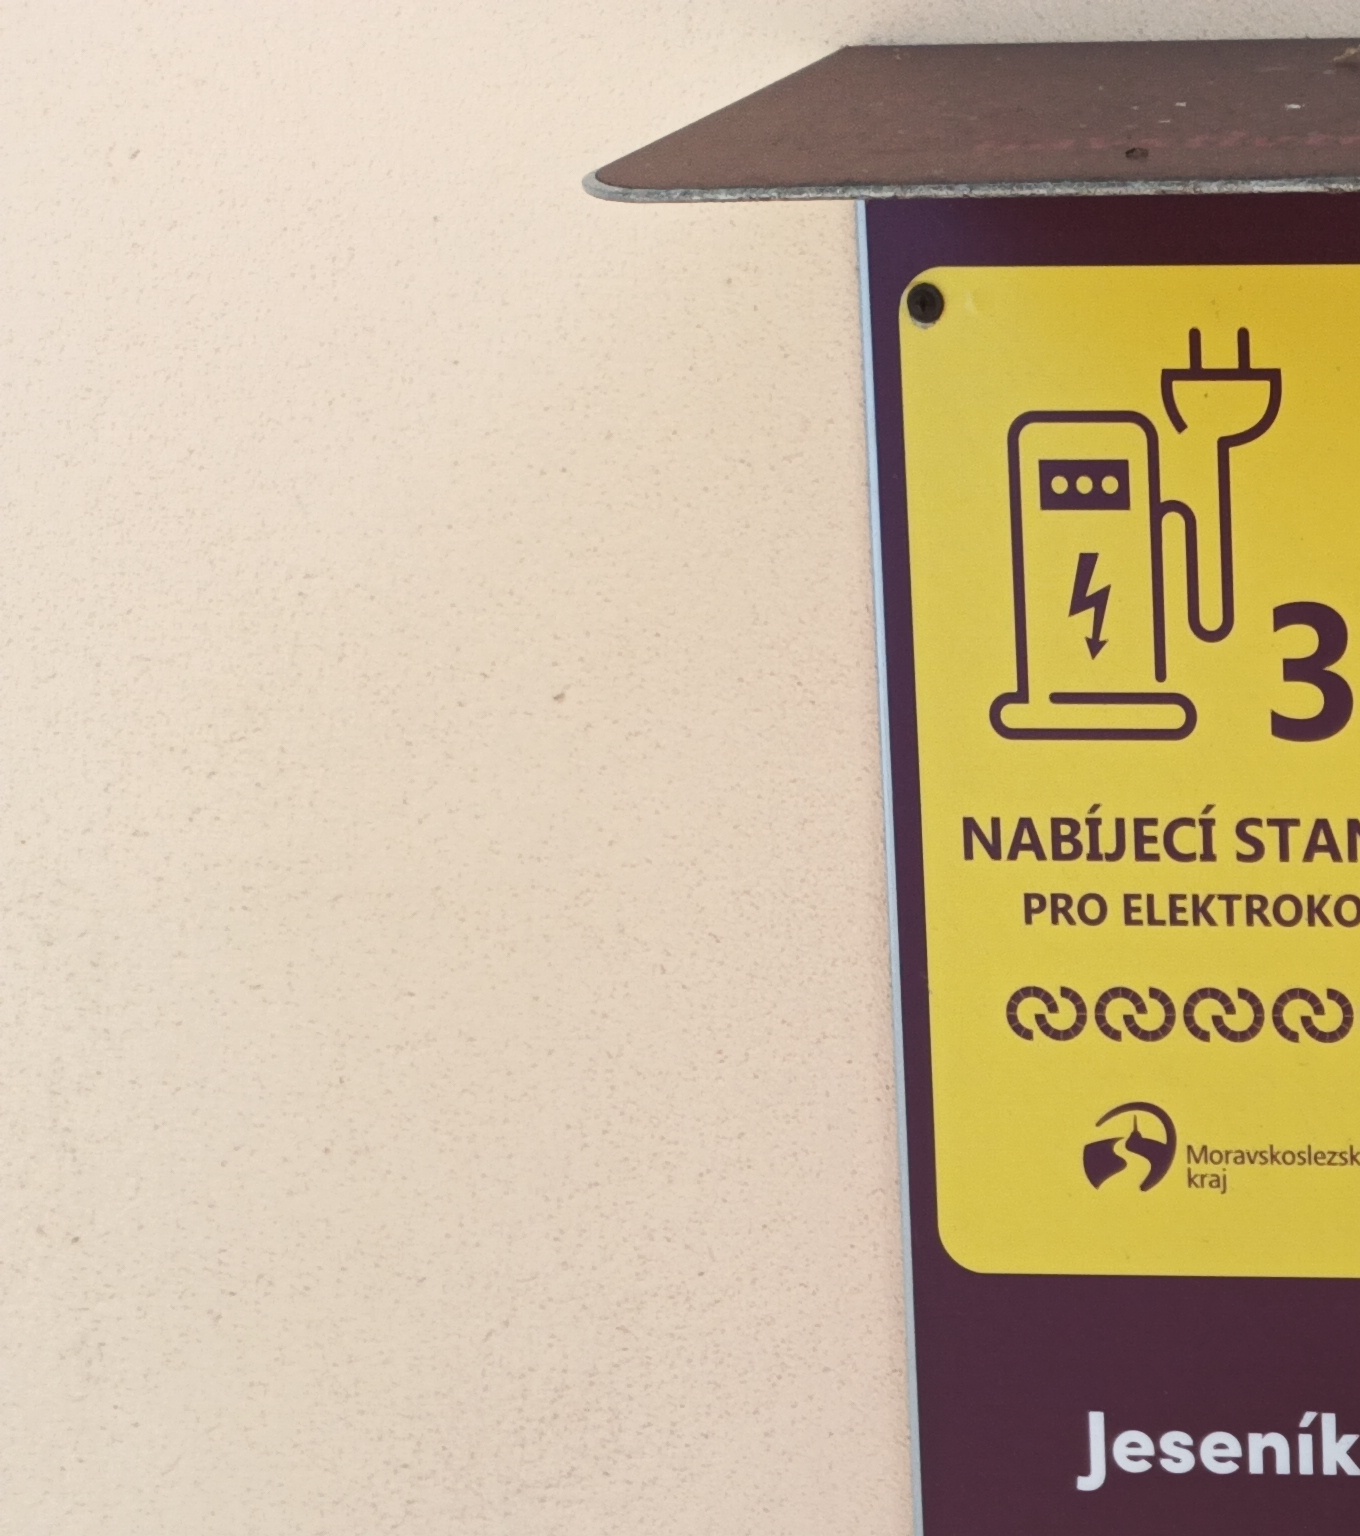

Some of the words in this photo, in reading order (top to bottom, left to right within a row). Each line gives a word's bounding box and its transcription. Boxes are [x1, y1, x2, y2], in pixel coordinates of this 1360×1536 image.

[962, 803, 1217, 863] NABÍJECÍ
[1023, 892, 1108, 927] PRO
[1186, 1167, 1228, 1195] kraj
